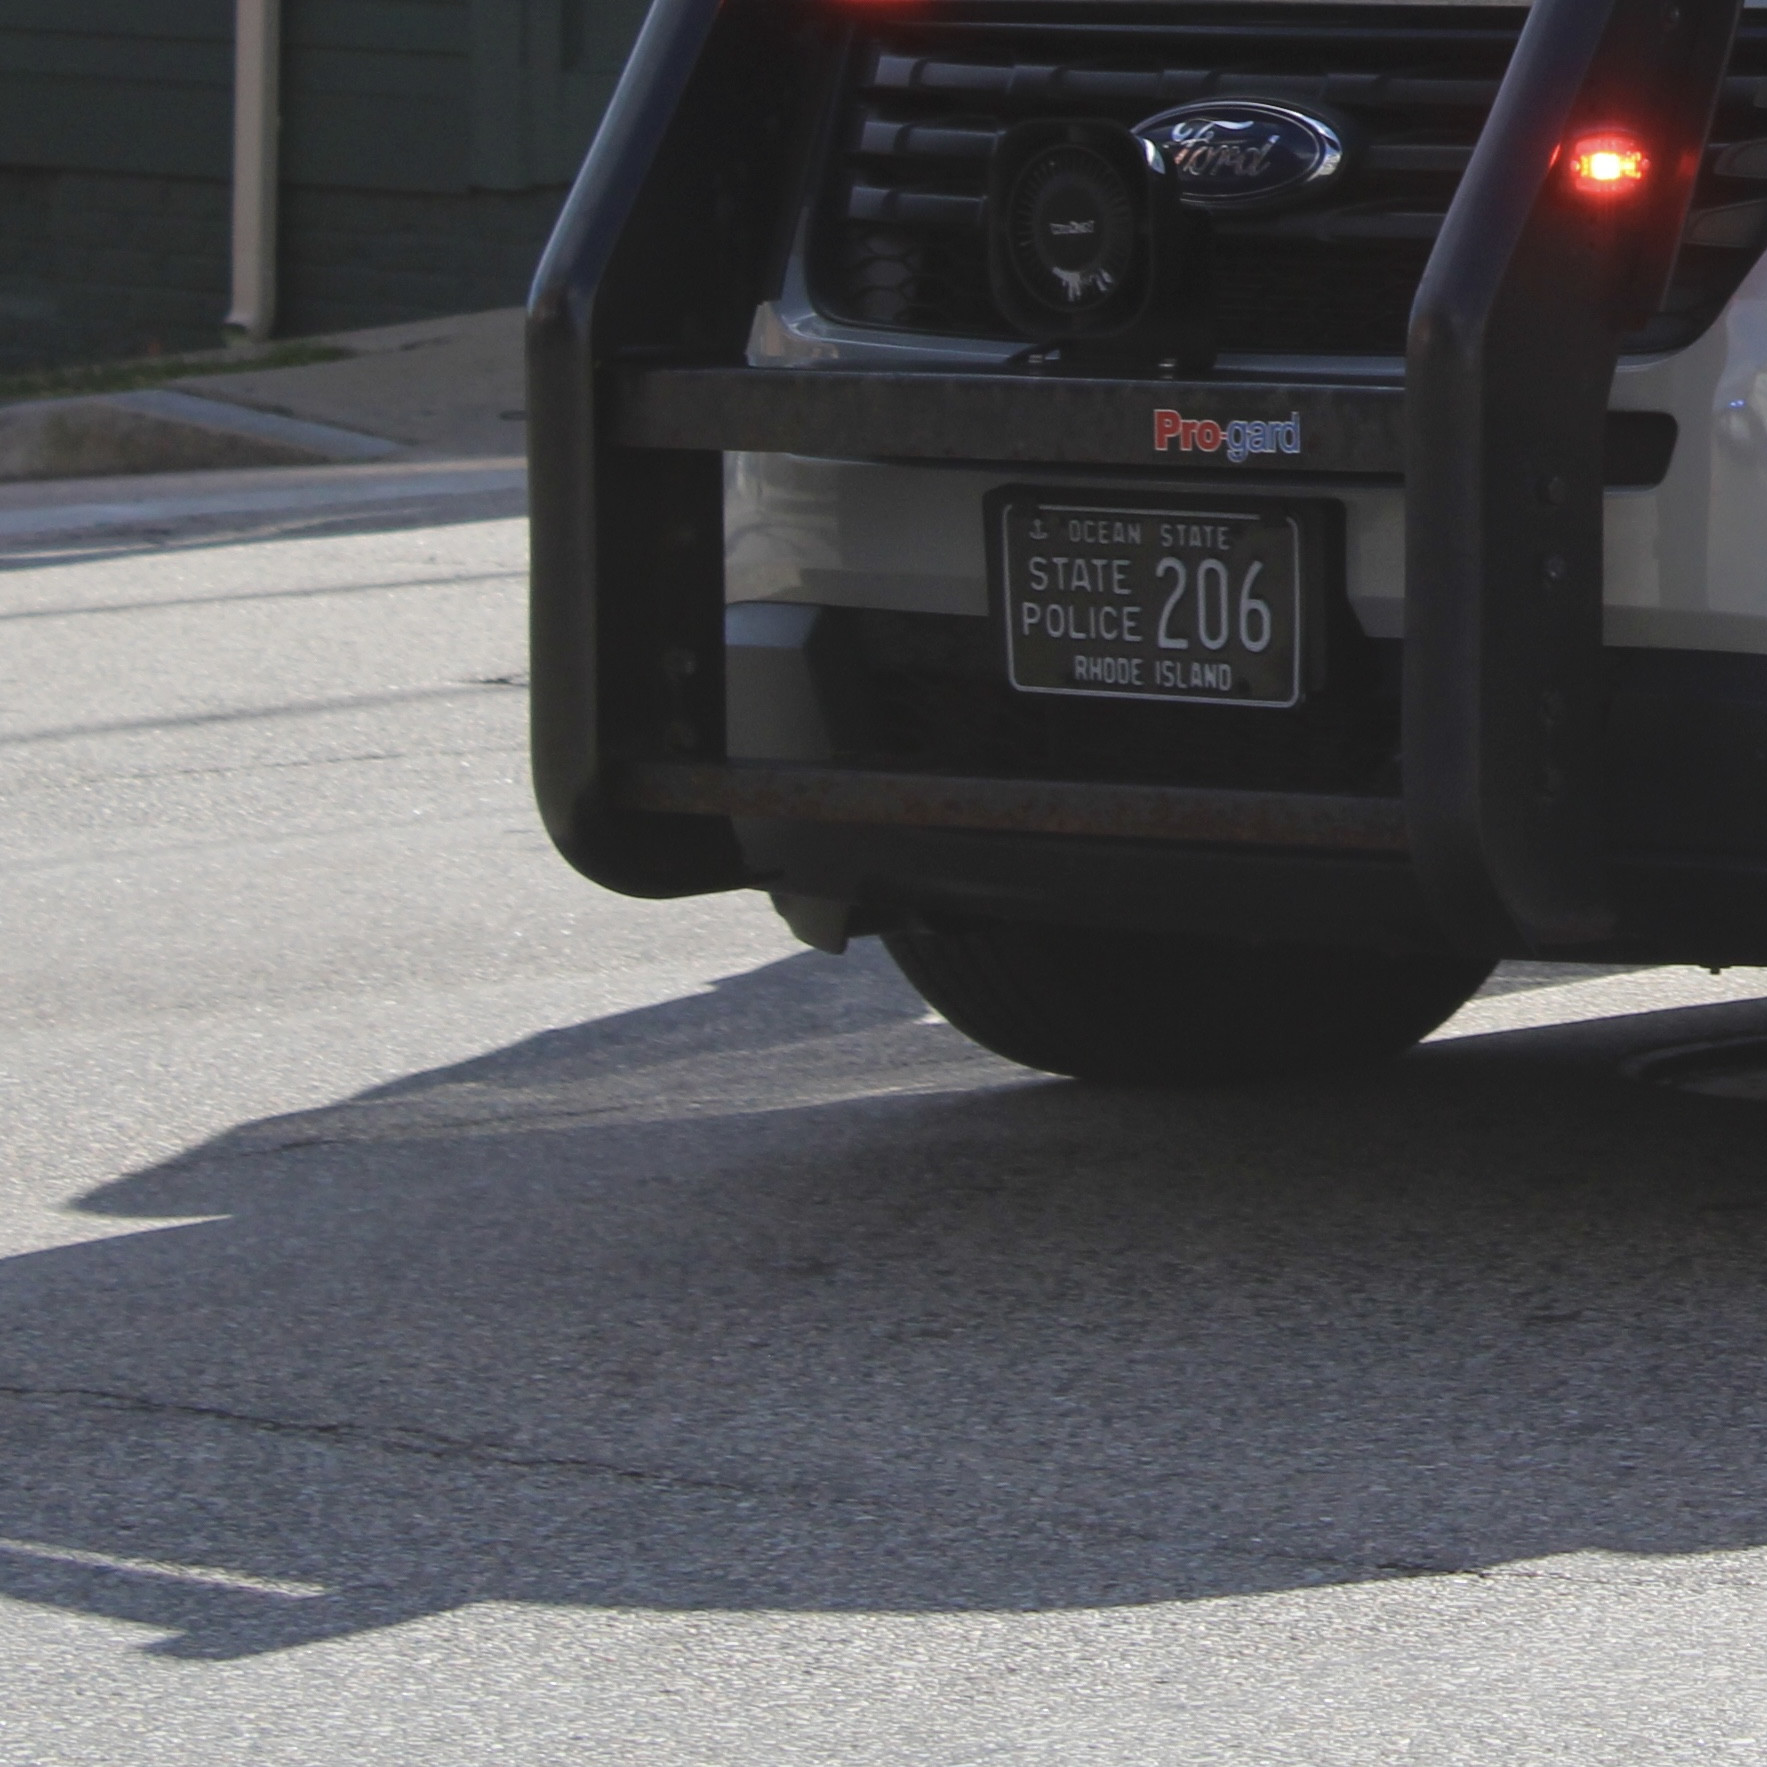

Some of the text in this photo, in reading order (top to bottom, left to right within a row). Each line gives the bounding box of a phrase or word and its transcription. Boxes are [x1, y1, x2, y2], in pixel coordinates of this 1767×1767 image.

[1165, 118, 1280, 177] Ford
[1153, 408, 1301, 463] Pro-gard
[1068, 519, 1231, 551] OCEAN STATE
[1028, 556, 1133, 595] STATE
[1021, 601, 1144, 643] POLICE
[1154, 556, 1272, 654] 206
[1073, 654, 1232, 692] RHODE ISLAND
